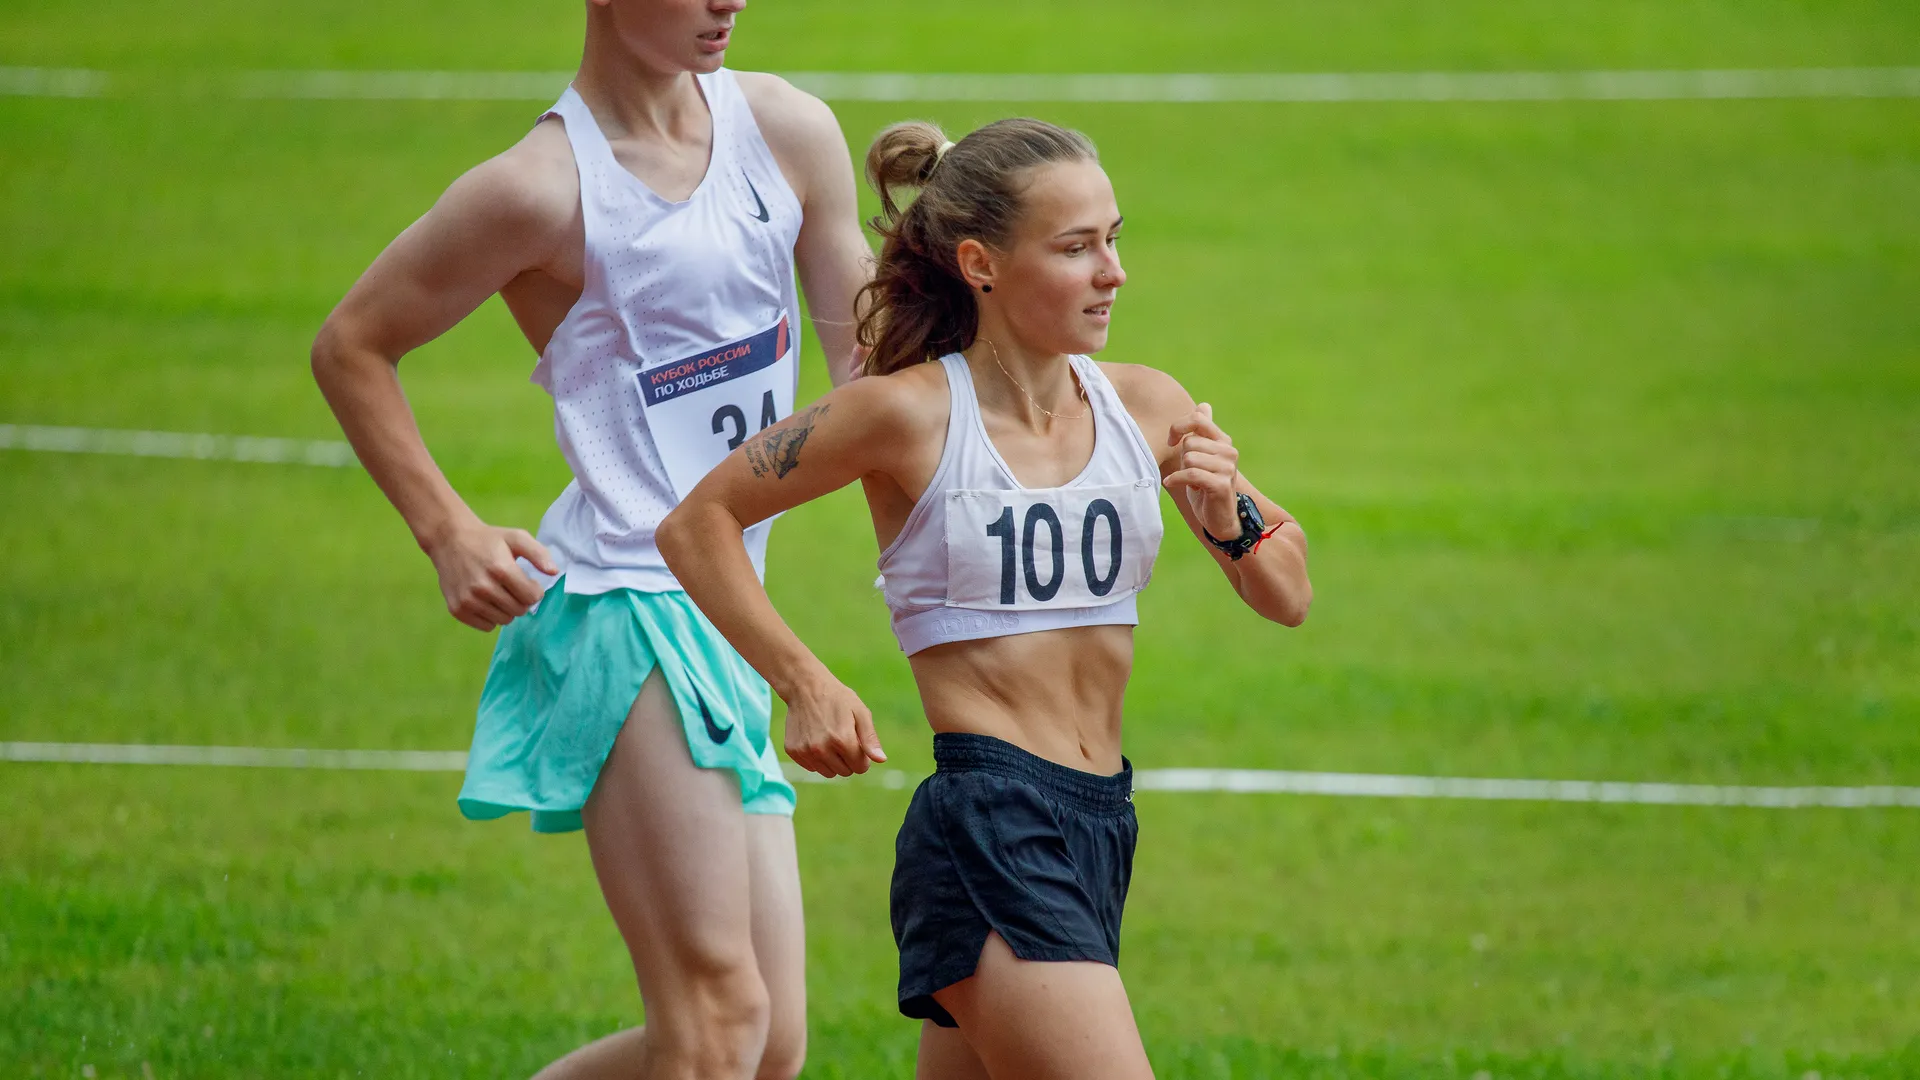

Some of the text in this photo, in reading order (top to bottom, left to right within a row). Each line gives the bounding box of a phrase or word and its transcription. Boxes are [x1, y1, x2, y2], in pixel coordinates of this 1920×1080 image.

[651, 343, 751, 384] КУБОК РОССИИ
[654, 365, 729, 398] ПО ХОДЬБЕ
[986, 498, 1122, 605] 100
[930, 611, 1020, 637] ADIDAS
